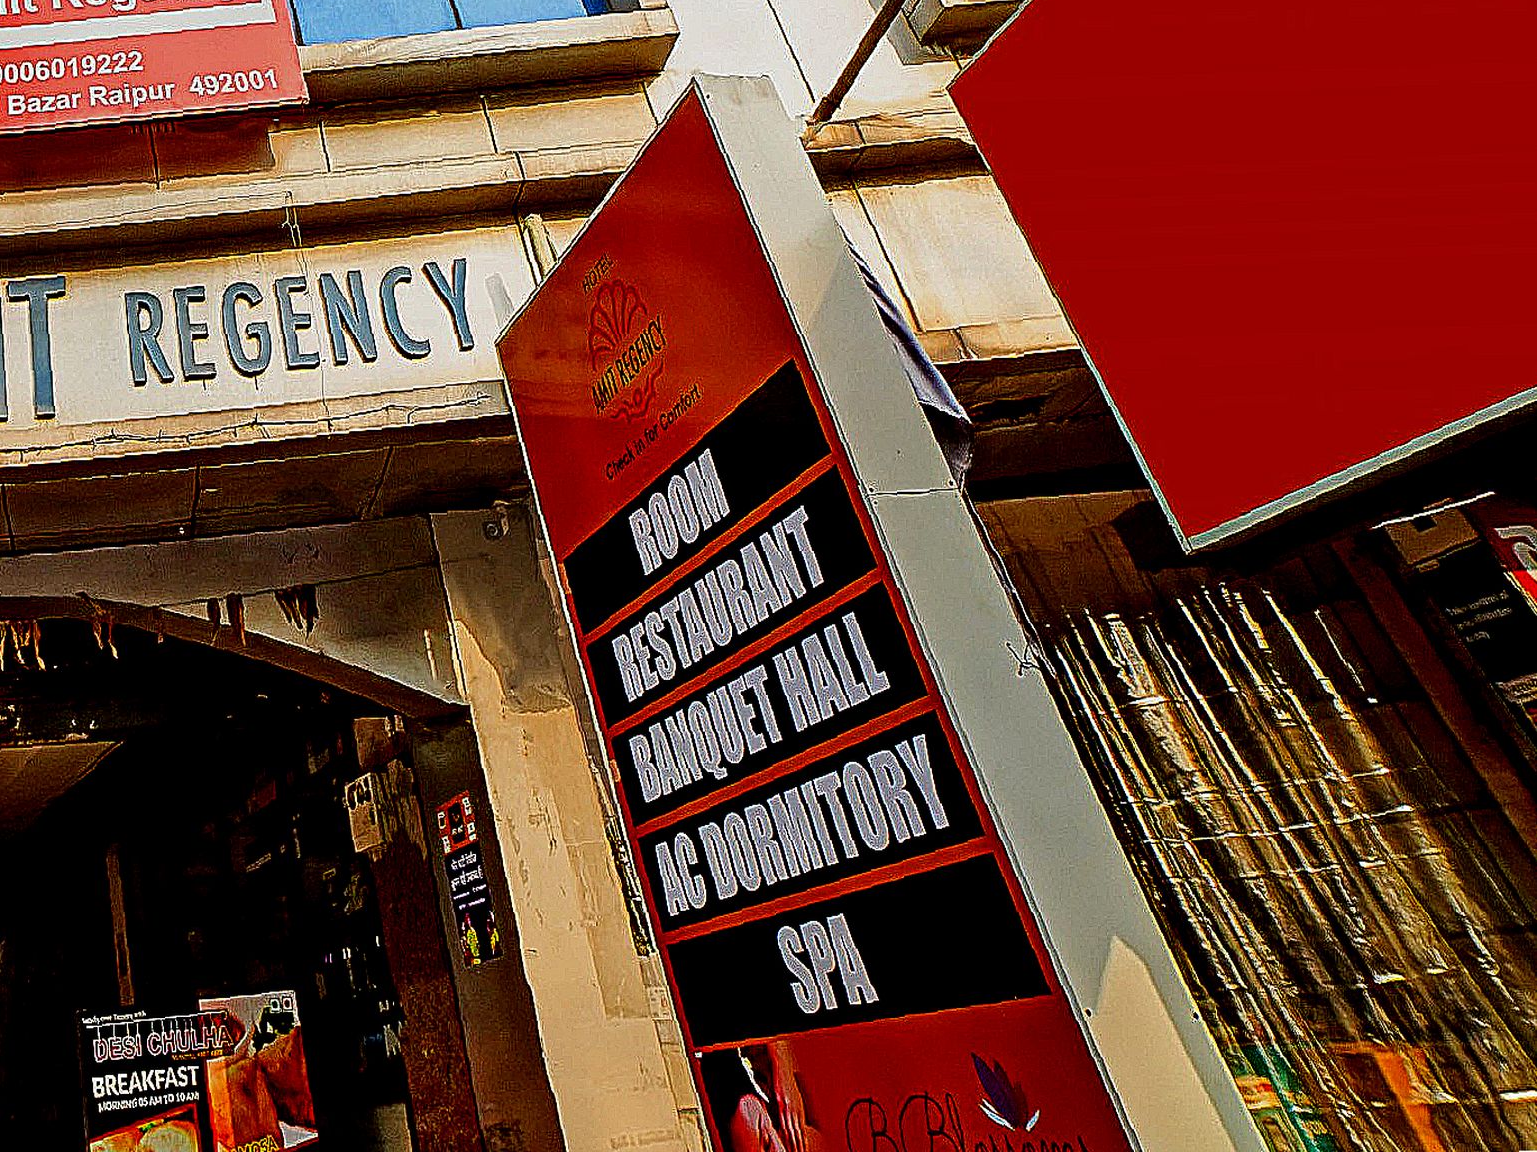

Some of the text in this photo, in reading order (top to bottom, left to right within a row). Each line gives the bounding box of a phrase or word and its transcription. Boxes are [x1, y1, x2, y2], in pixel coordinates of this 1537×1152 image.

[8, 91, 79, 116] Bazar
[90, 84, 175, 108] Raipur
[188, 69, 278, 98] 492001
[123, 257, 475, 386] REGENCY
[582, 254, 614, 295] HOTEL
[591, 315, 667, 414] AMIT REGENCY
[606, 383, 702, 480] Check in for Comfort
[628, 448, 730, 575] ROOM
[611, 505, 825, 702] RESTAURANT
[629, 612, 890, 802] BANQUET HALL
[655, 735, 949, 915] AC DORMITORY
[777, 913, 879, 1014] SPA
[92, 1066, 199, 1098] BREAKFAST
[93, 1025, 234, 1063] DESI CHULHA
[98, 1098, 138, 1113] MORNING
[163, 1094, 174, 1103] TO
